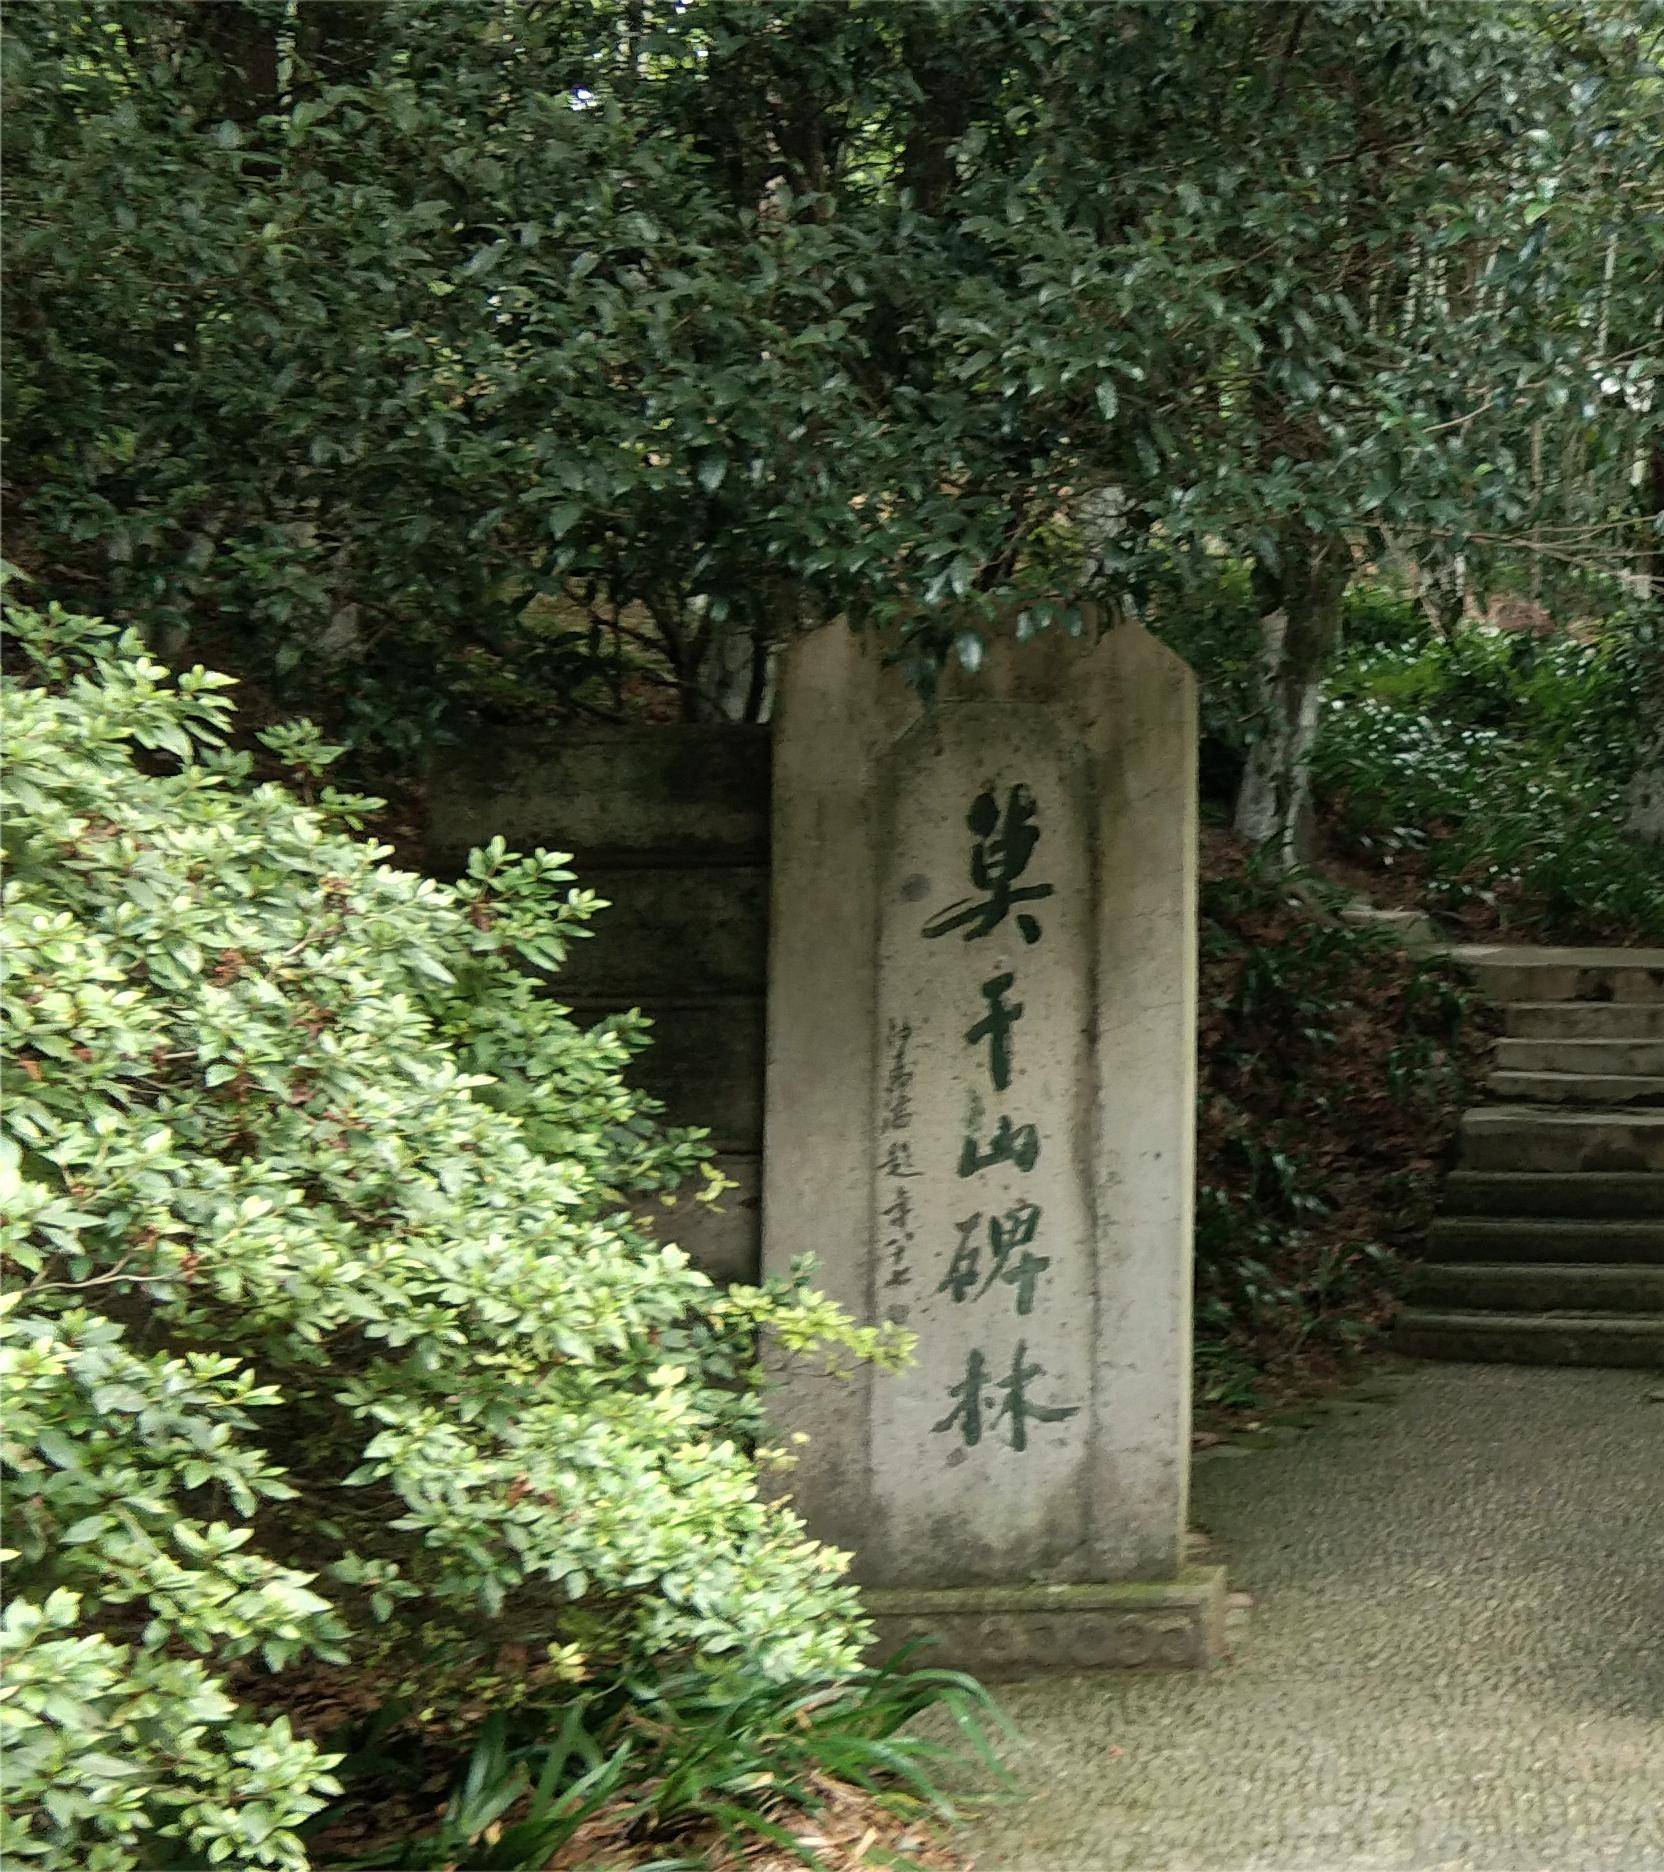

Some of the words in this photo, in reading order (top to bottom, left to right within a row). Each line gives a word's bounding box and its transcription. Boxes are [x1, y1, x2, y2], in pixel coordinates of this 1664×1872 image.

[920, 784, 1080, 1451] 莫干山碑林
